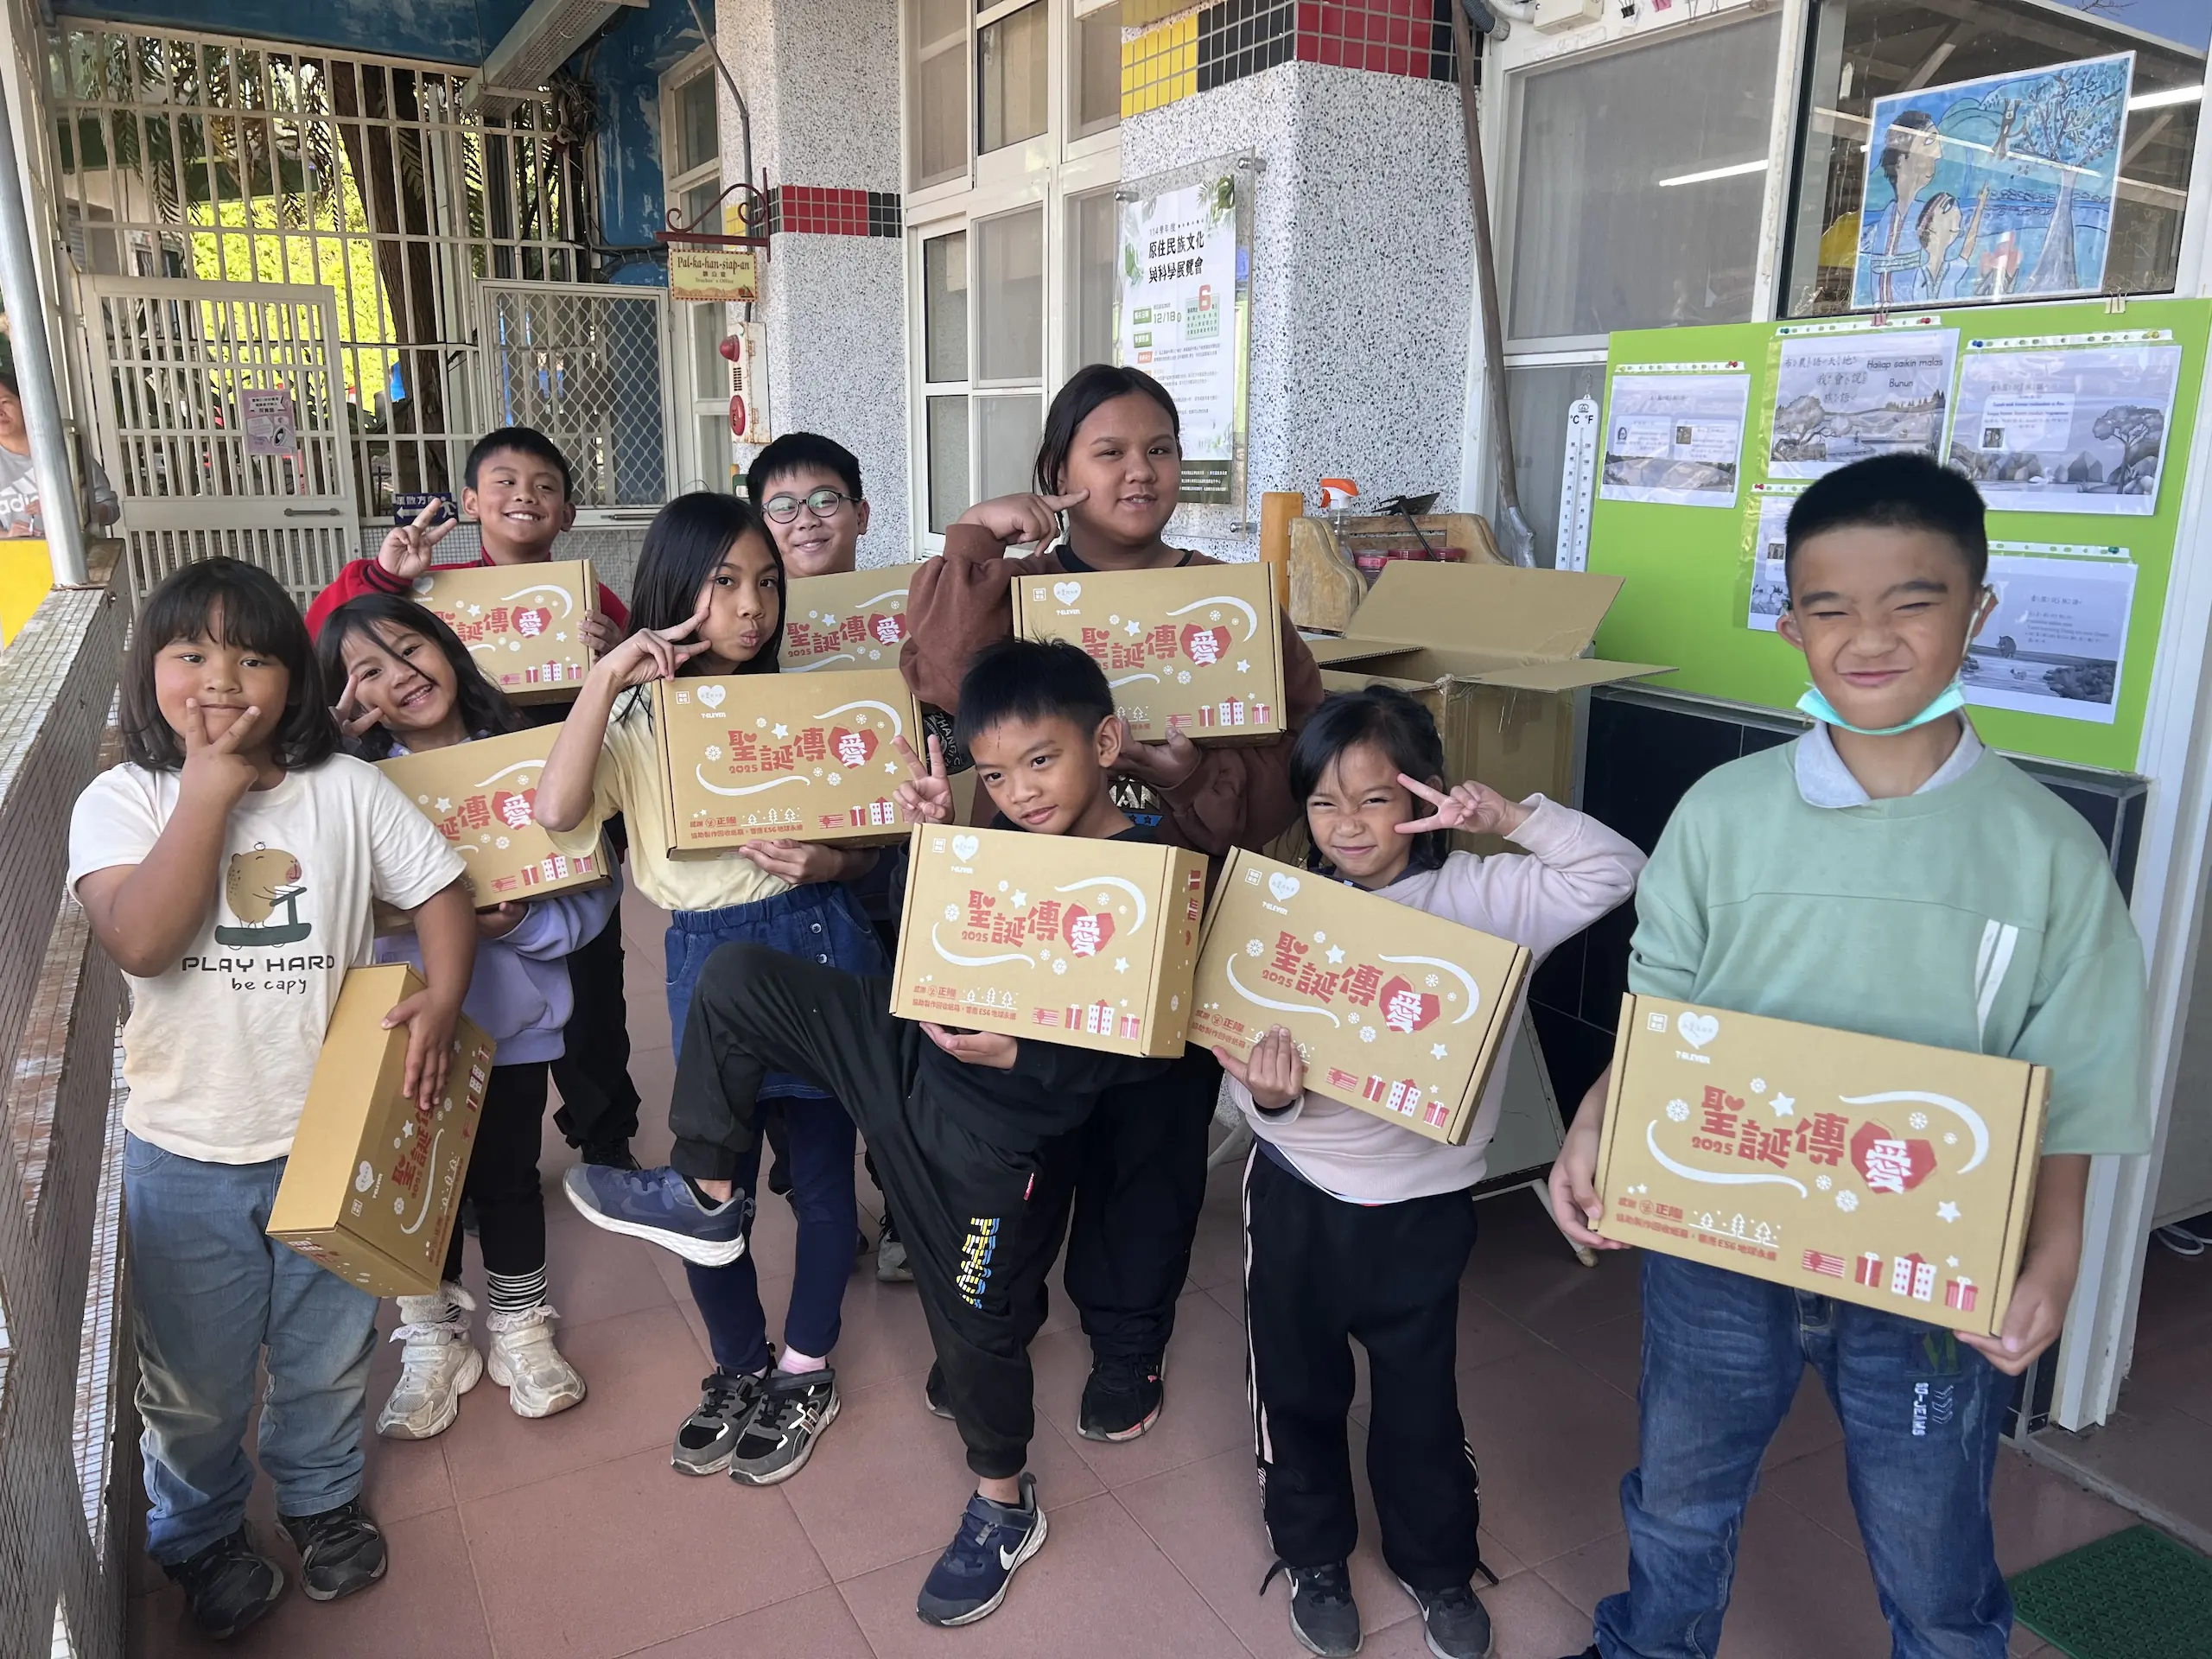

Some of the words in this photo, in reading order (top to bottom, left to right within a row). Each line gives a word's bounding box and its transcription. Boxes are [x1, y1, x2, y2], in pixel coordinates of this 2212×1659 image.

[1148, 230, 1205, 259] 原住民族文化
[677, 255, 750, 275] Pal-ka-han-siap-an
[1148, 256, 1204, 284] 與科學展覽會
[1198, 284, 1211, 312] 6
[1894, 356, 1917, 369] saikin
[1919, 353, 1943, 367] malas
[1890, 378, 1914, 388] Bunun
[787, 648, 811, 658] 2025
[728, 764, 758, 774] 2025
[961, 930, 988, 943] 2025
[182, 957, 254, 973] PLAY
[266, 955, 334, 972] HARD
[232, 978, 256, 991] be
[264, 978, 307, 995] capy
[1261, 969, 1294, 988] 2025
[1691, 1135, 1733, 1157] 2025
[1700, 1084, 1911, 1194] 聖誕傳愛
